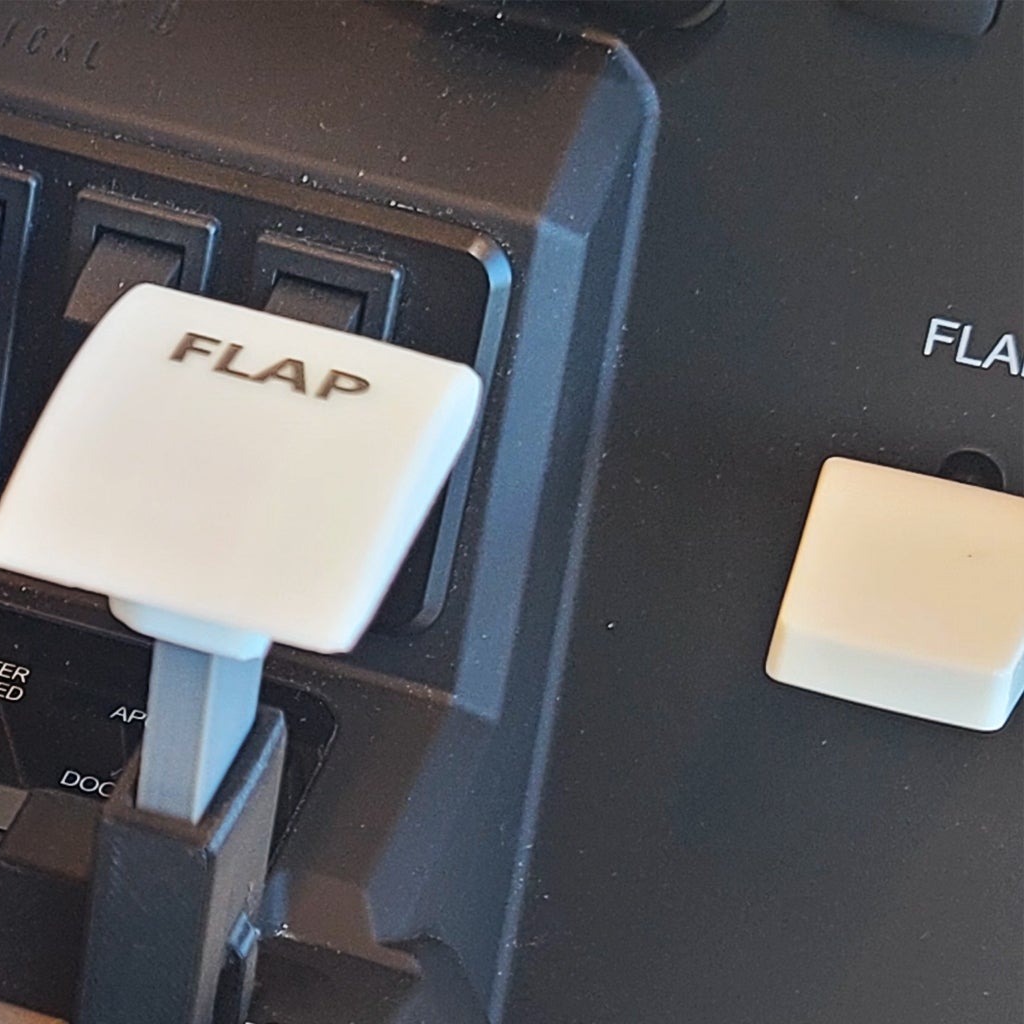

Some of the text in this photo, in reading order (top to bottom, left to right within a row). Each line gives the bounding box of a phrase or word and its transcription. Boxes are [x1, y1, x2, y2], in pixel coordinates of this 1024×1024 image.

[169, 331, 371, 401] FLAP
[923, 317, 1024, 378] FLA
[109, 705, 147, 723] AP
